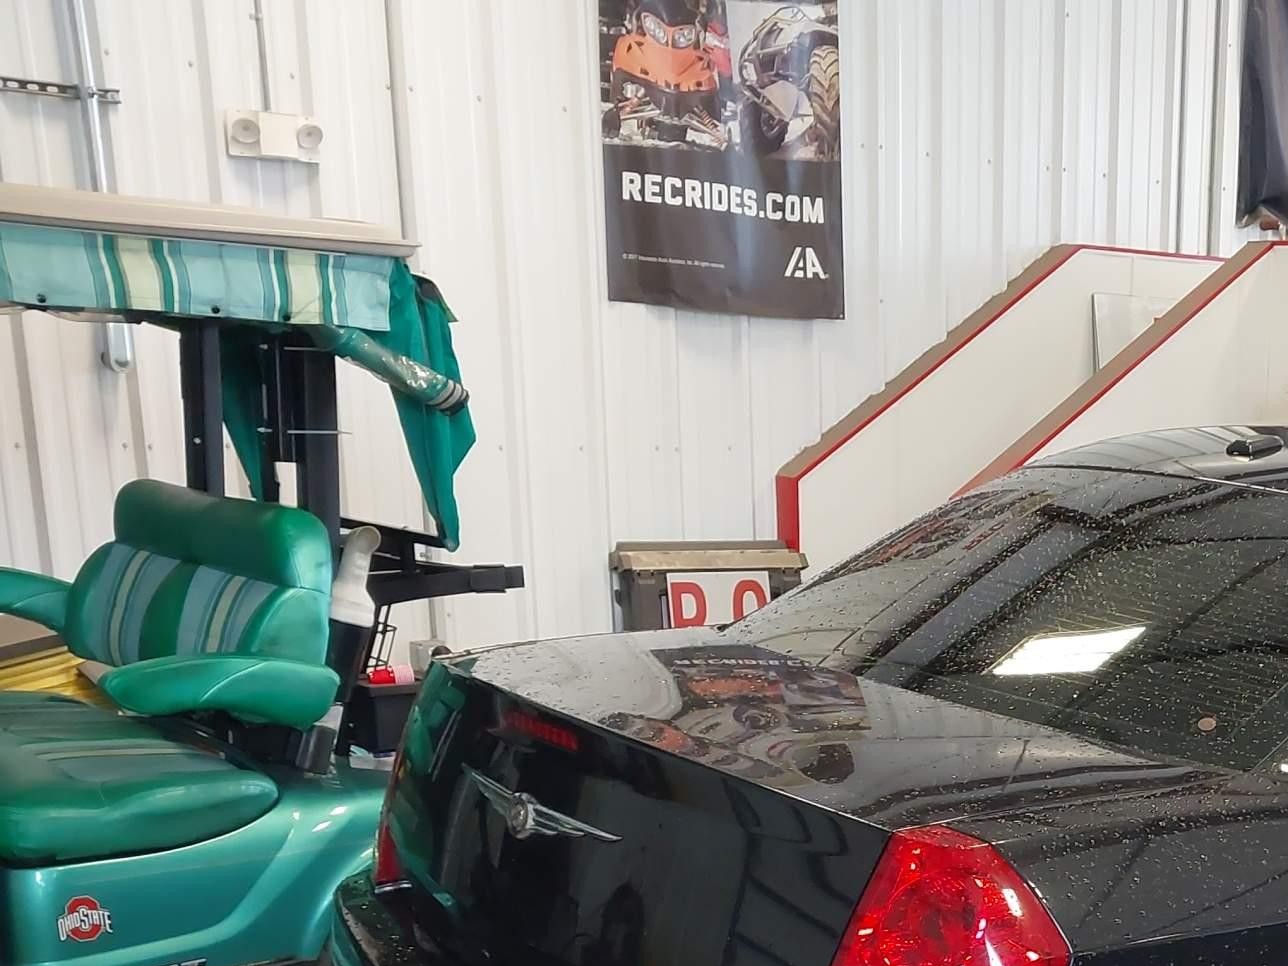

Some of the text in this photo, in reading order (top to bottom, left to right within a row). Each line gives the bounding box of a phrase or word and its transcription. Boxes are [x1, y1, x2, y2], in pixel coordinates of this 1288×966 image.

[621, 171, 825, 224] RECRIDES.COM
[57, 908, 113, 941] OHIO STATE
